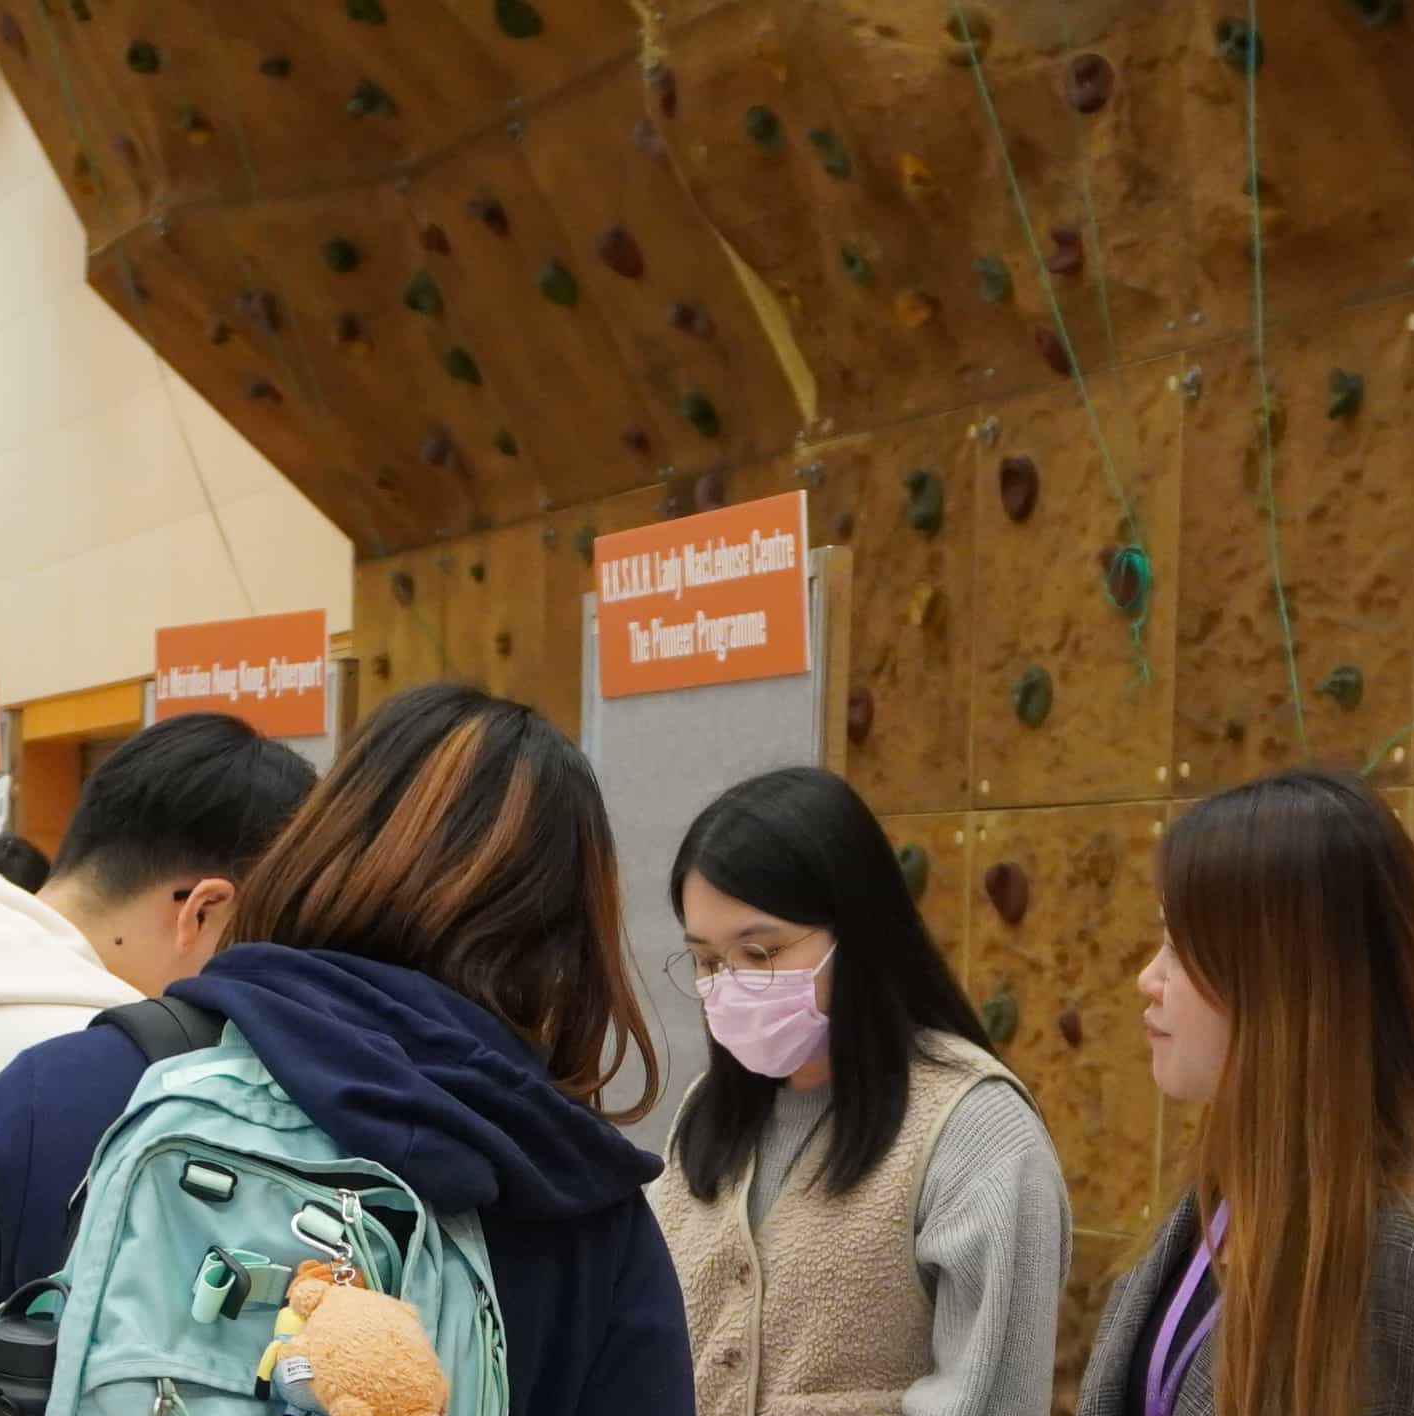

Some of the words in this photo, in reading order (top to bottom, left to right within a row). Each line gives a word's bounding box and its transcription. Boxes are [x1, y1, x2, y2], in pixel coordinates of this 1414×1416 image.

[655, 548, 683, 600] Lady
[683, 536, 750, 587] MacLehose
[751, 528, 796, 575] Centre
[628, 622, 650, 663] The
[651, 617, 695, 660] Pioneer
[696, 609, 767, 662] Programme
[212, 662, 237, 701] Hong
[269, 656, 323, 699] Cyberport
